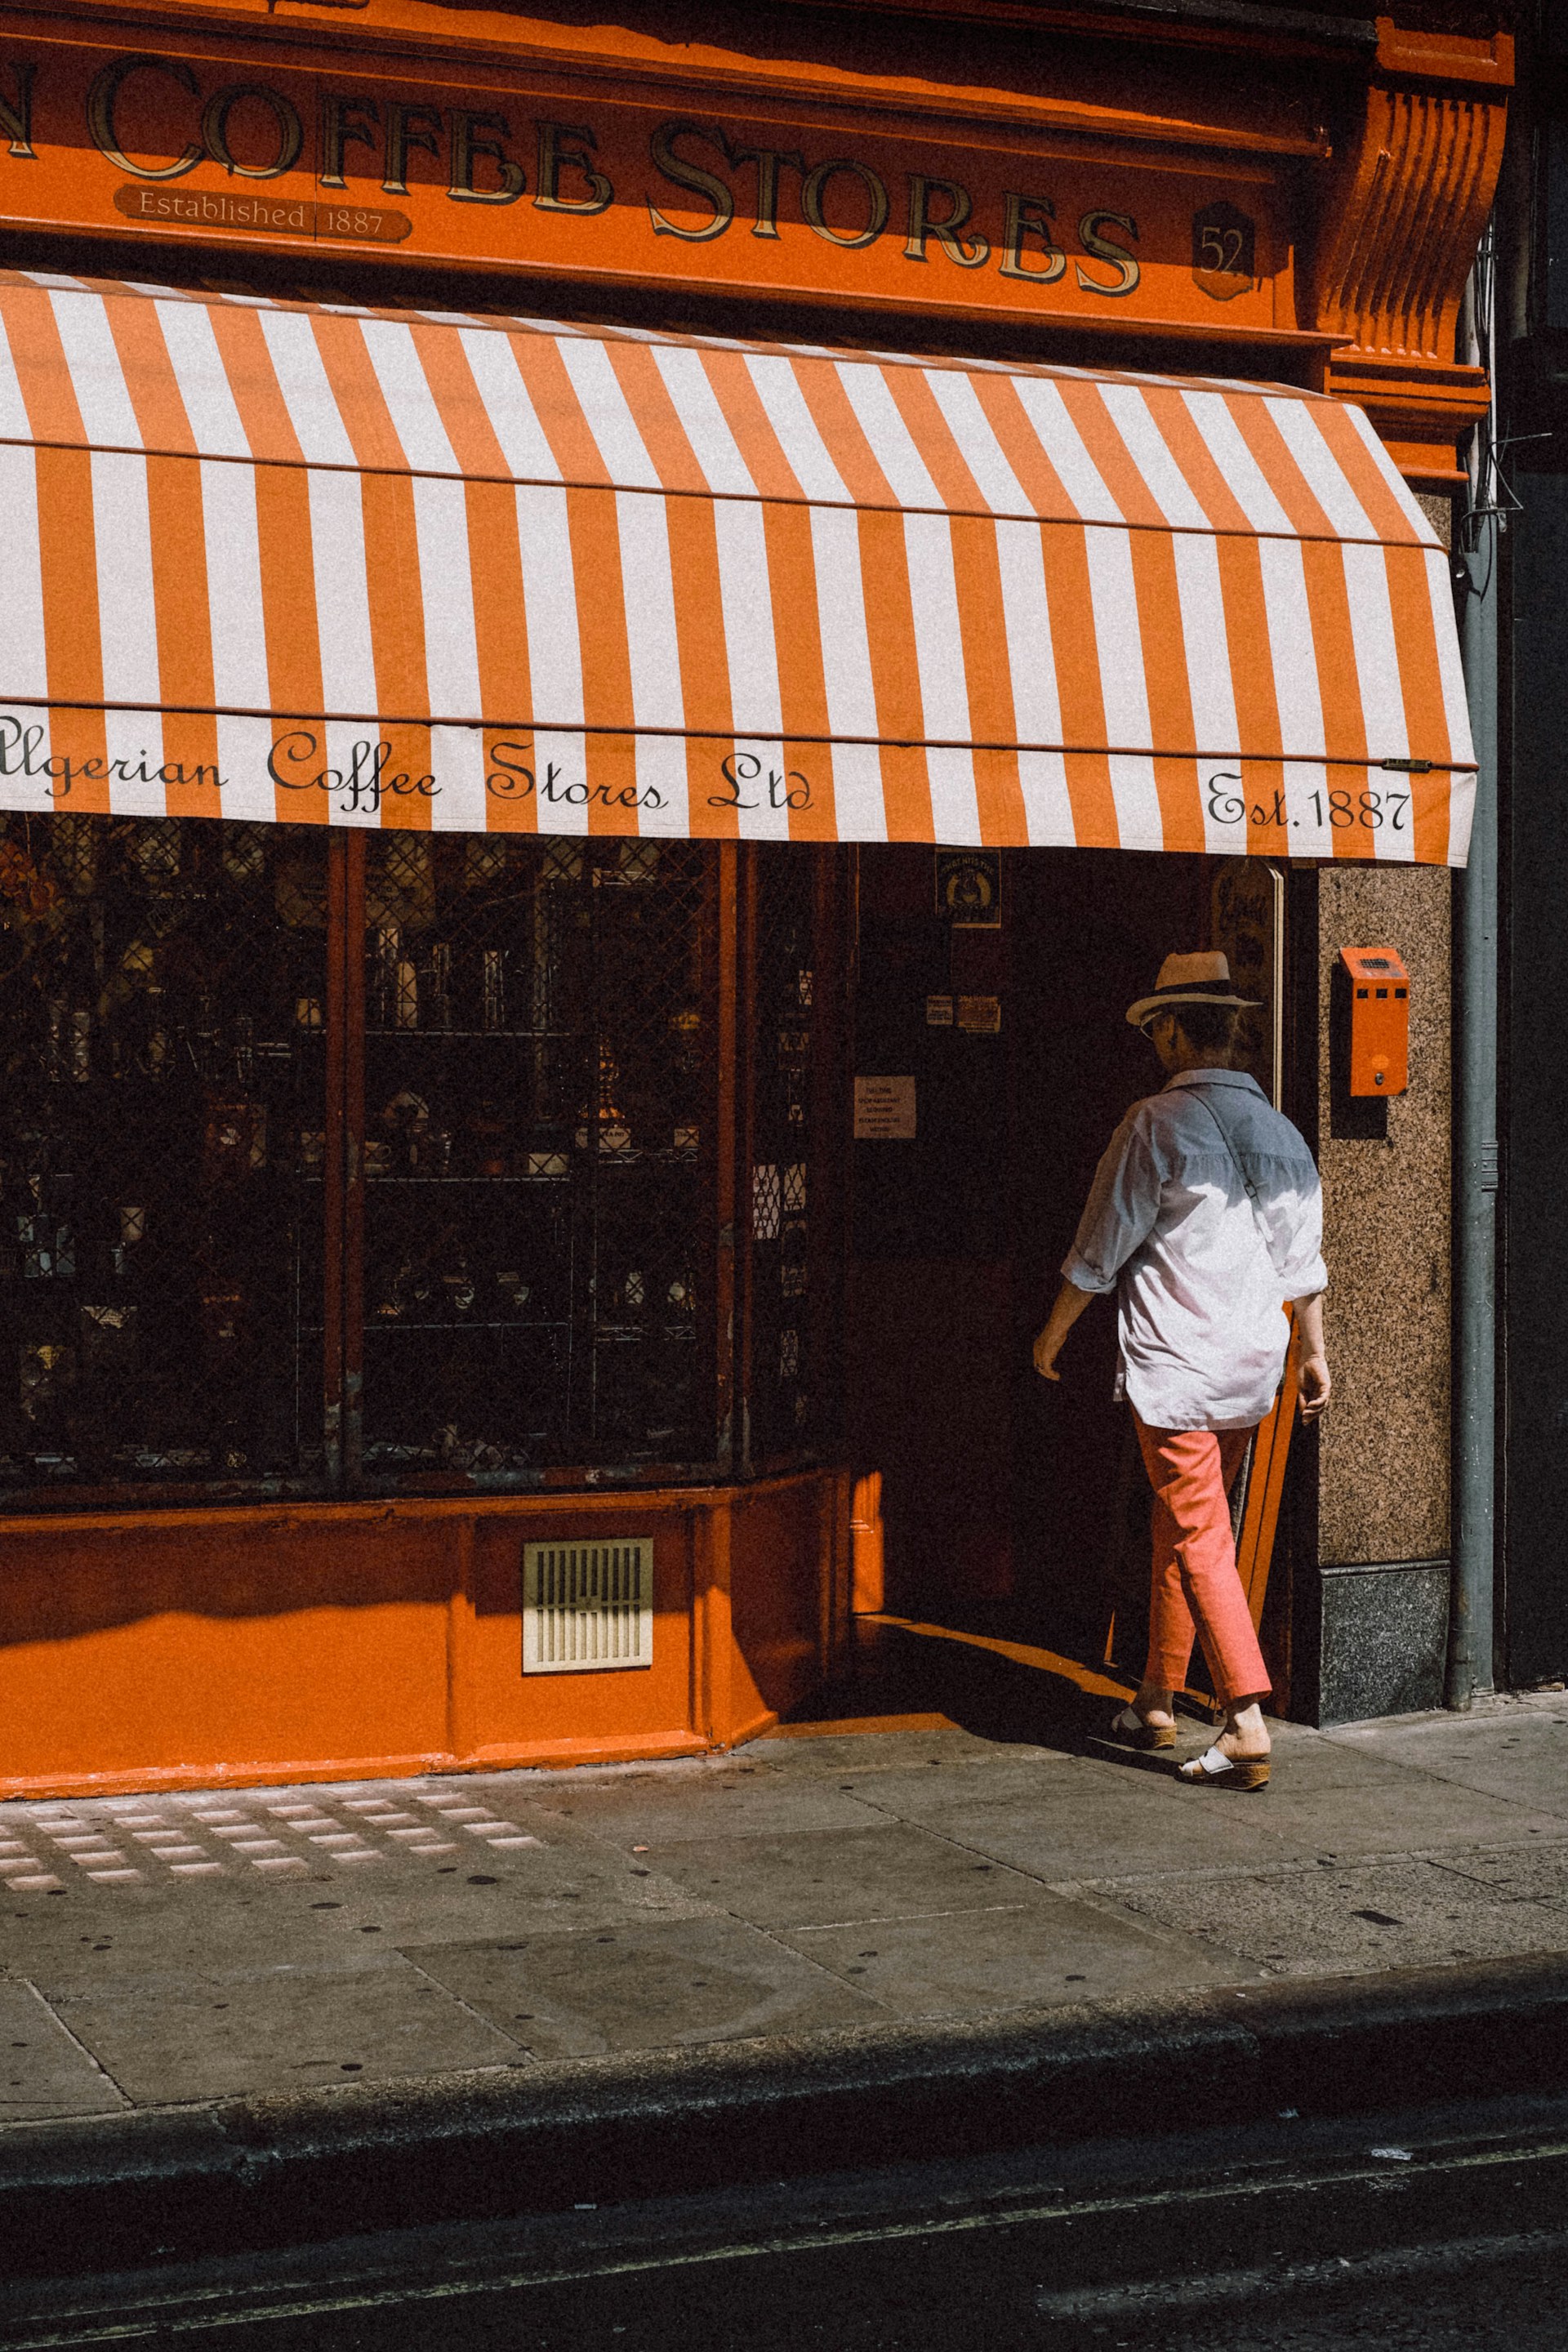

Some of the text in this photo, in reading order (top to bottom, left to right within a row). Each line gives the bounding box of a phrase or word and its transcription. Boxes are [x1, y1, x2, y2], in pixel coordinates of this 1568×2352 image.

[139, 192, 384, 235] Established 1887
[646, 121, 1141, 297] STORES
[1202, 225, 1245, 276] 52
[266, 731, 443, 813] Coffee
[488, 742, 669, 810] Stores
[707, 752, 813, 810] Ltd
[1307, 790, 1410, 831] 1887
